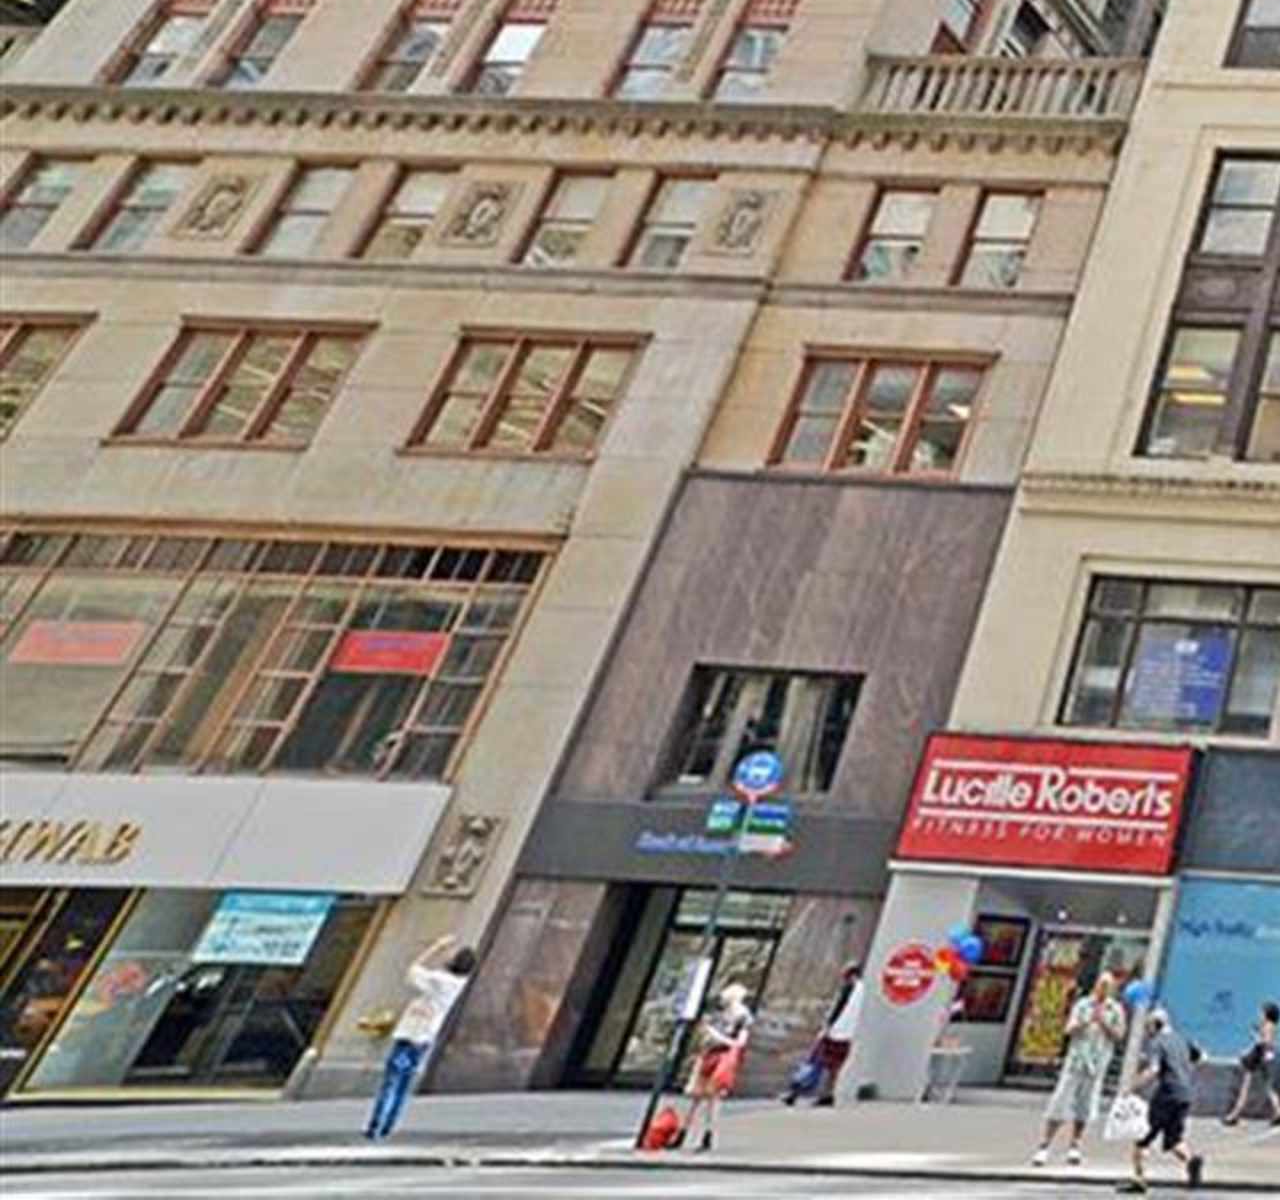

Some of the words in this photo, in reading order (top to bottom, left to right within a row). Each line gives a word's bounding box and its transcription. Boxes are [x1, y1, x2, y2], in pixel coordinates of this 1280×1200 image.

[921, 768, 1032, 807] Lucille
[1035, 767, 1173, 817] Roberts
[911, 817, 1009, 840] FITNESS
[1019, 822, 1065, 840] FOR
[1077, 825, 1167, 848] WOMEN
